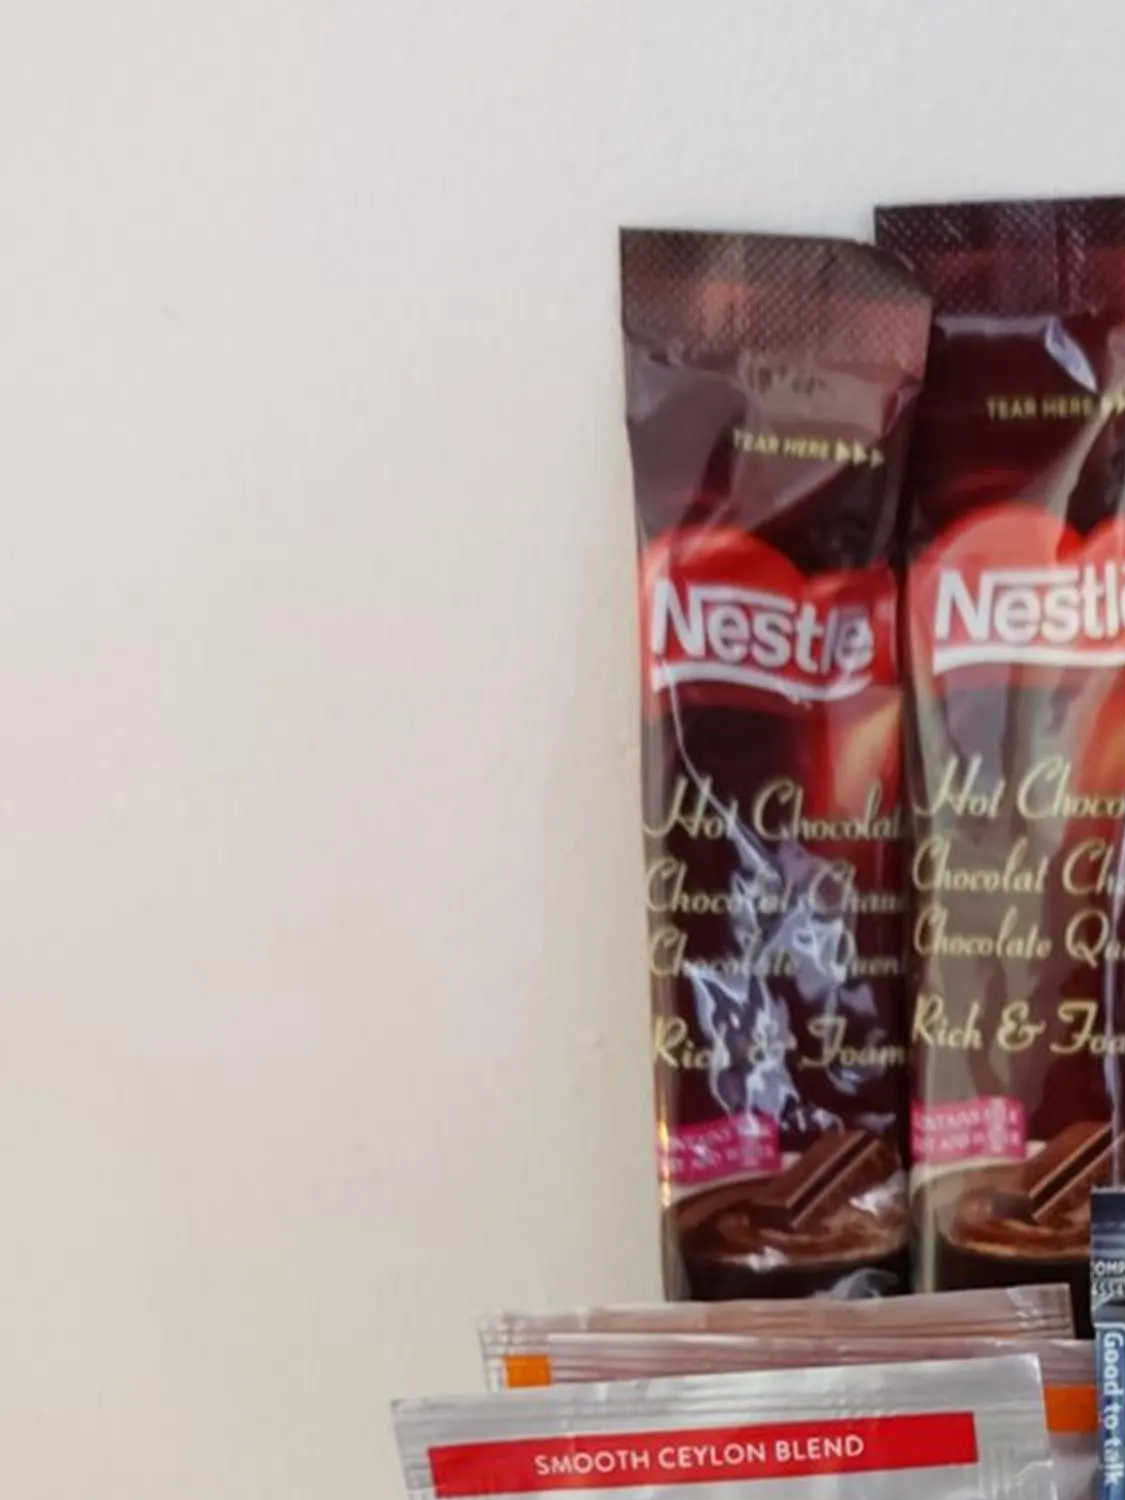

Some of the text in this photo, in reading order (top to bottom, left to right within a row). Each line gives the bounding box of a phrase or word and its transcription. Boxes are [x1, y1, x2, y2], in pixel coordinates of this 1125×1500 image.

[733, 428, 830, 461] TEAR HERE
[911, 752, 1007, 820] Hot
[911, 834, 1049, 893] Chocolat
[913, 903, 1052, 959] Chocolate
[912, 993, 983, 1049] Rich
[996, 999, 1047, 1052] &
[1102, 1331, 1125, 1398] Good
[534, 1434, 865, 1477] SMOOTH CEYLON BLEND
